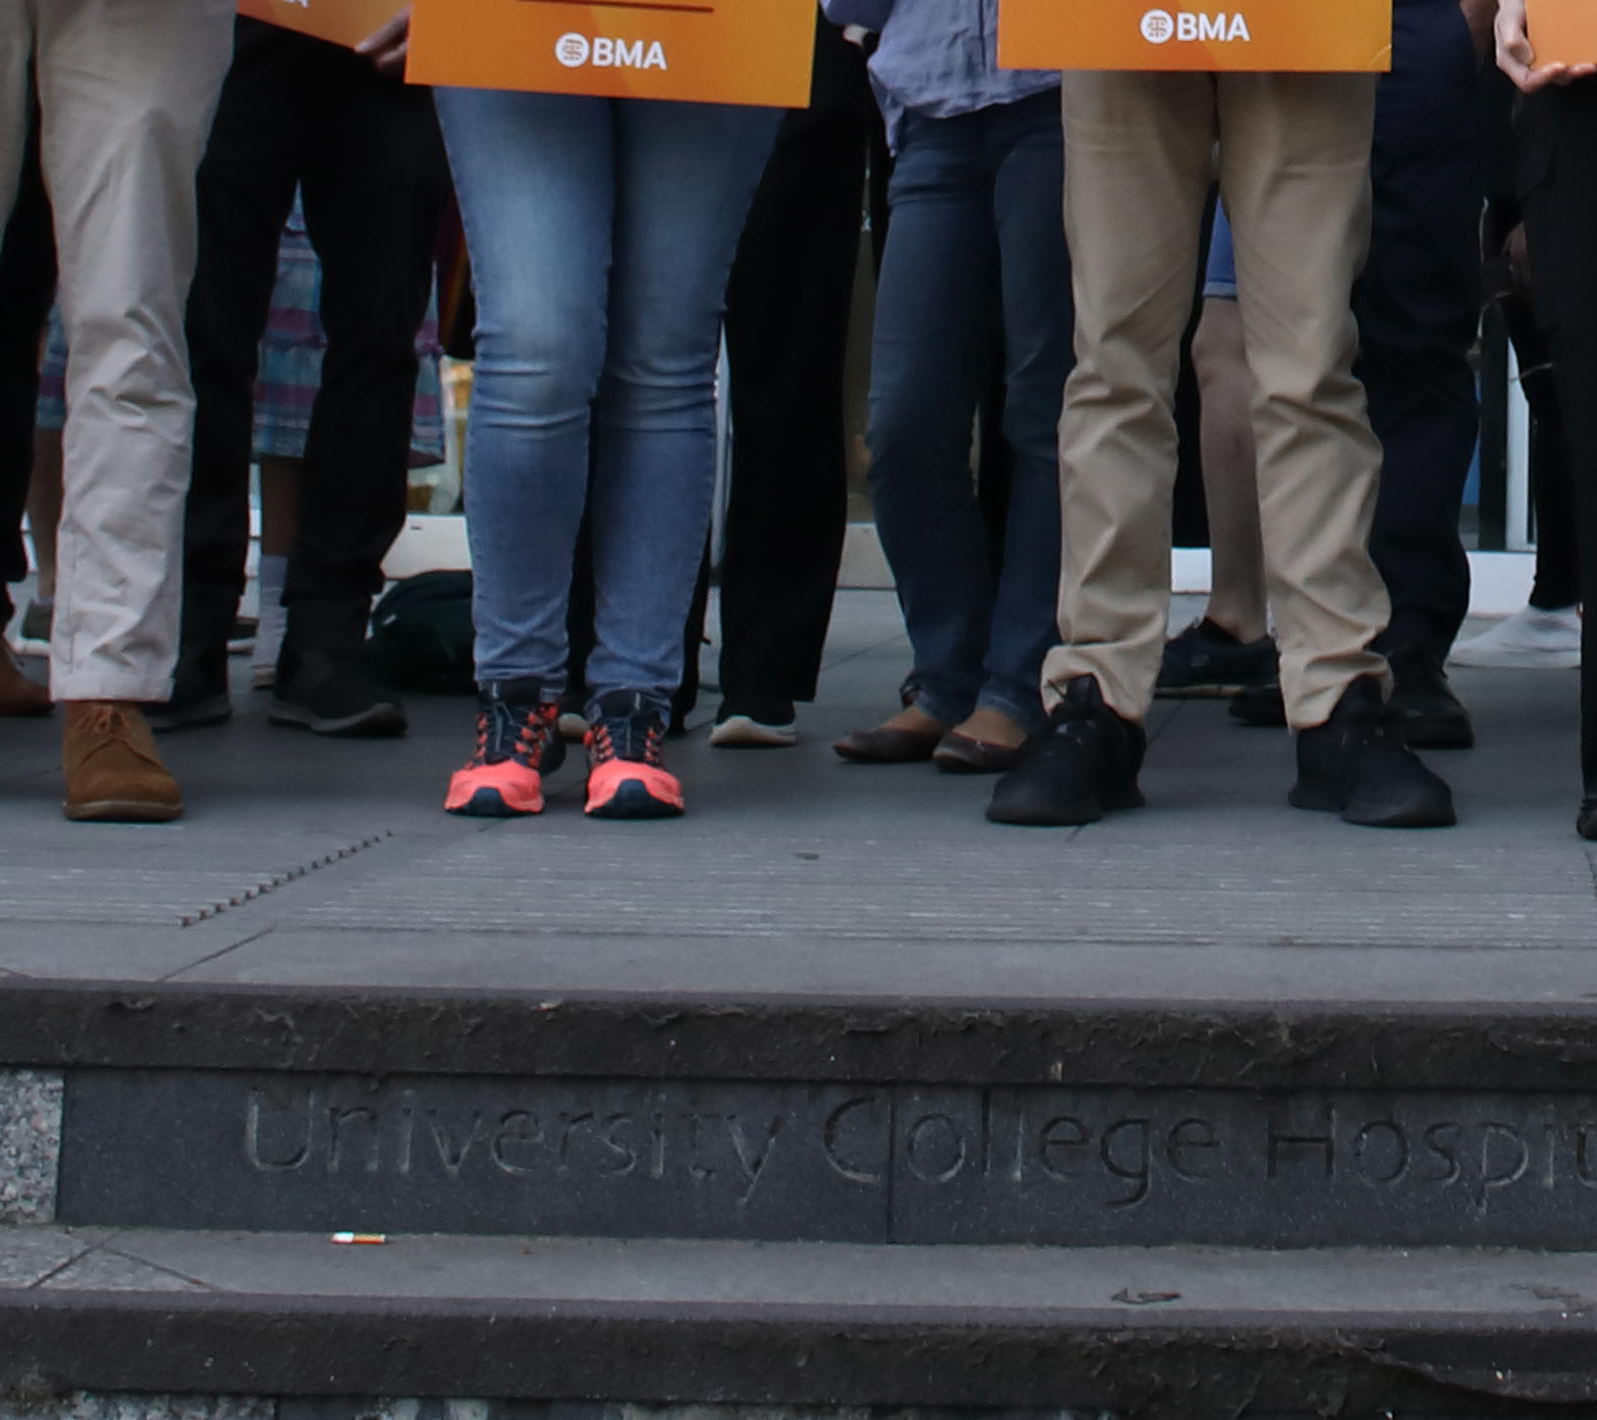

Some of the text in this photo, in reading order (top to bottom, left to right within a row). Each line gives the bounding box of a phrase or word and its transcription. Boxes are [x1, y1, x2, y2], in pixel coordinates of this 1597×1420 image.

[1176, 12, 1250, 41] BMA
[592, 37, 667, 69] BMA
[246, 1086, 782, 1209] University
[823, 1091, 1225, 1212] College
